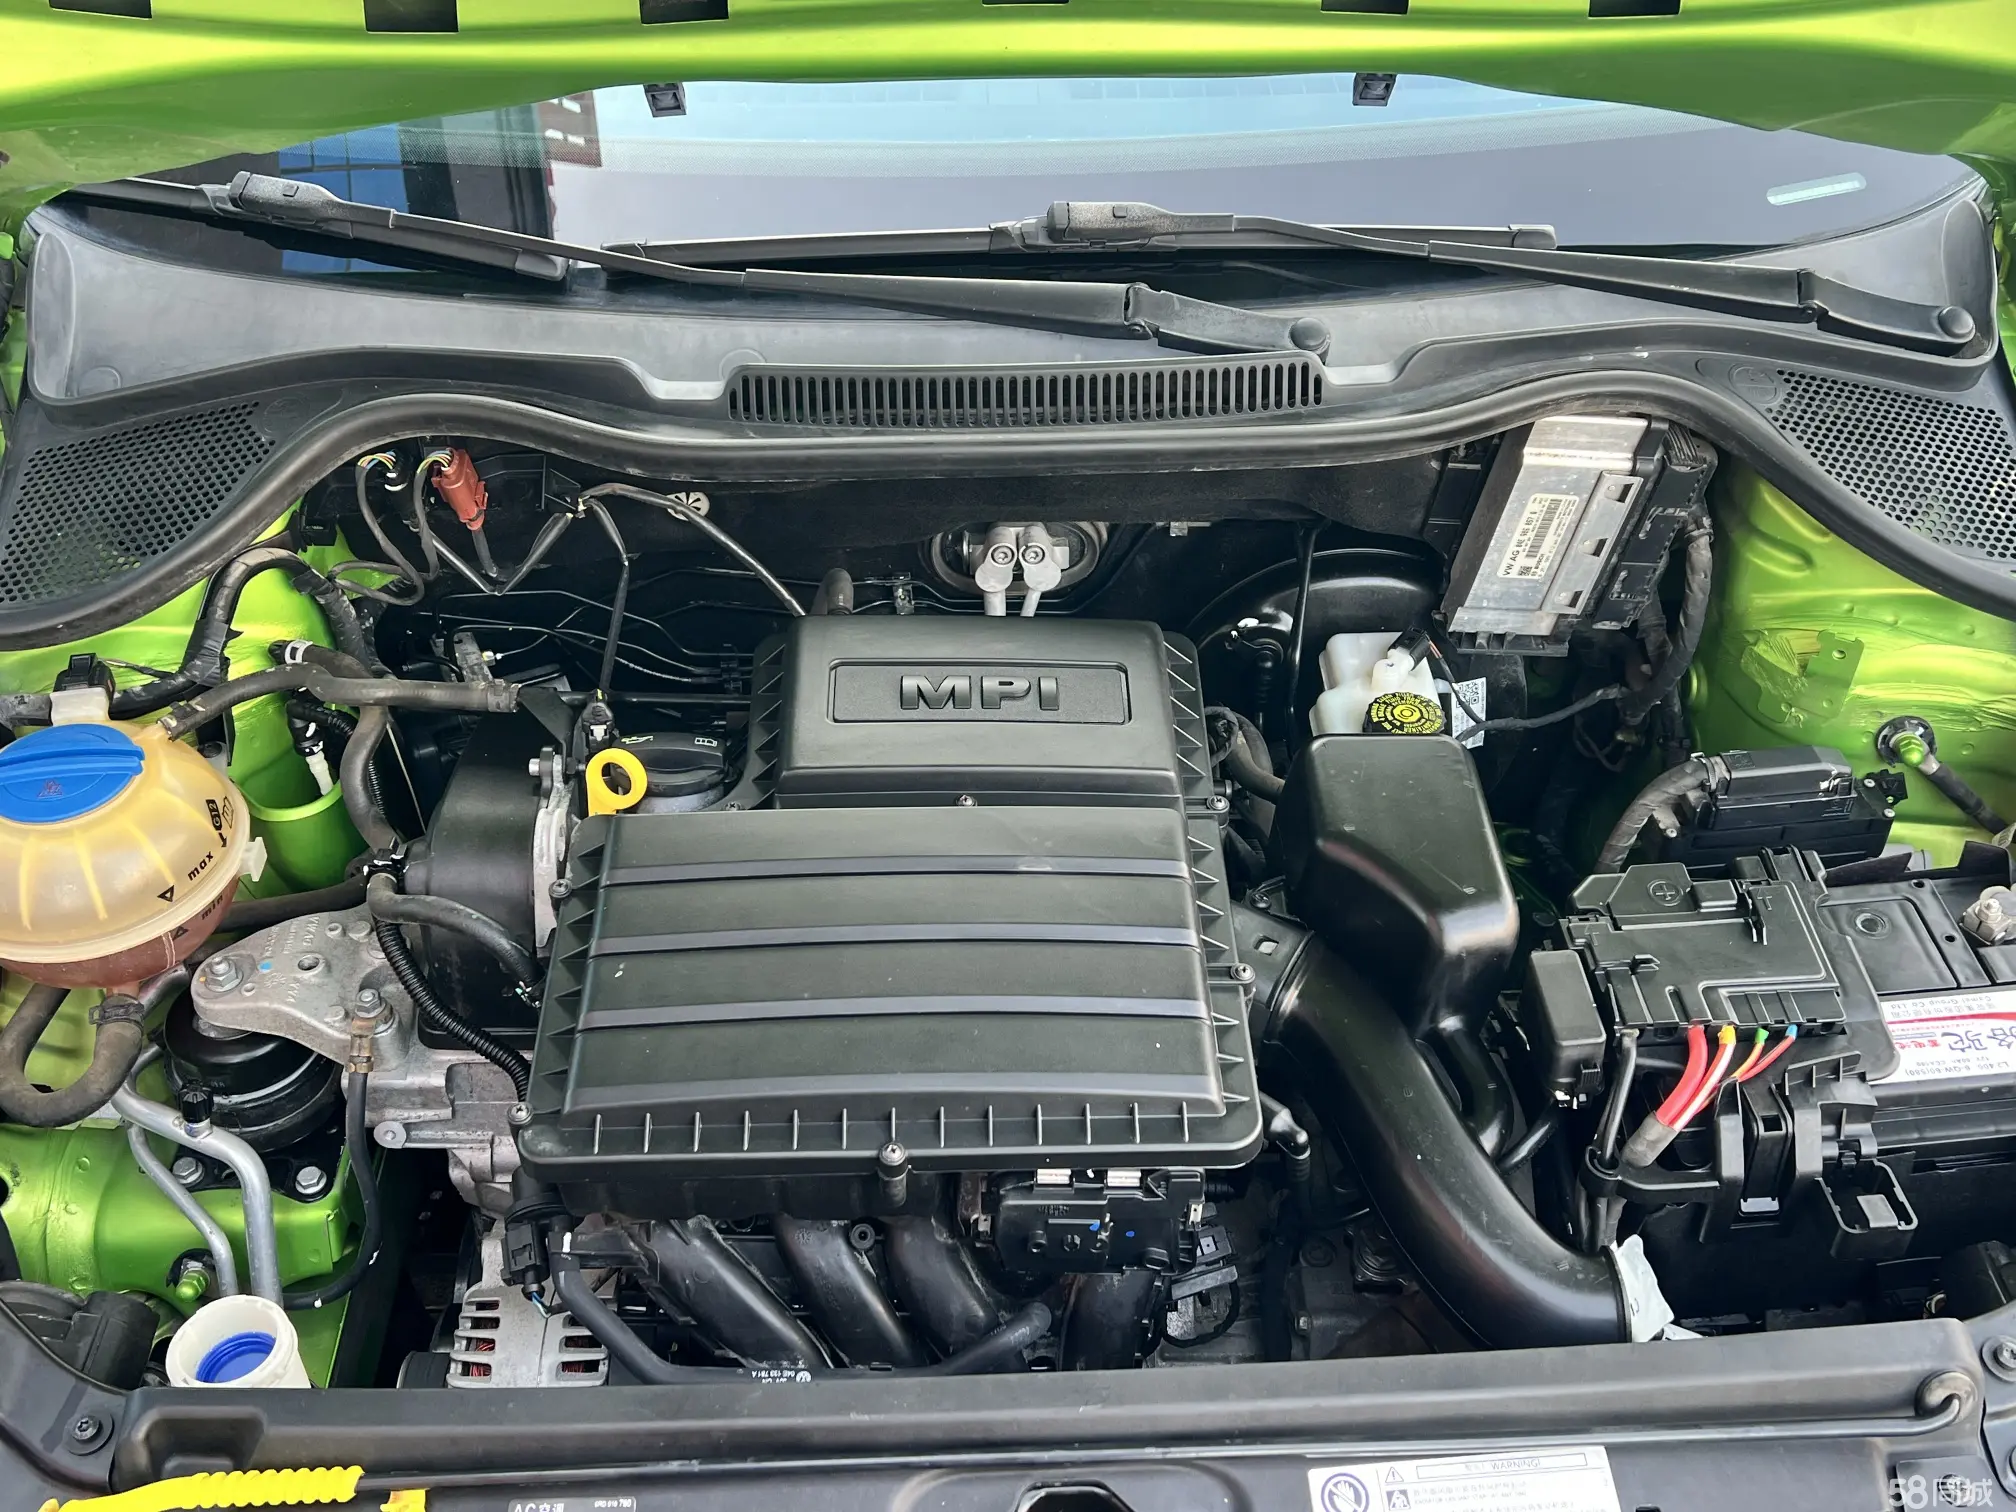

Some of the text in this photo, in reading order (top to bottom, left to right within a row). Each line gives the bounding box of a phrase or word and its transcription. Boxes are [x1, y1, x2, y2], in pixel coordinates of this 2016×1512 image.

[900, 674, 1060, 711] MPI
[208, 802, 221, 827] G12
[187, 851, 214, 881] max
[202, 895, 223, 921] min
[1491, 1459, 1541, 1470] WARNING!
